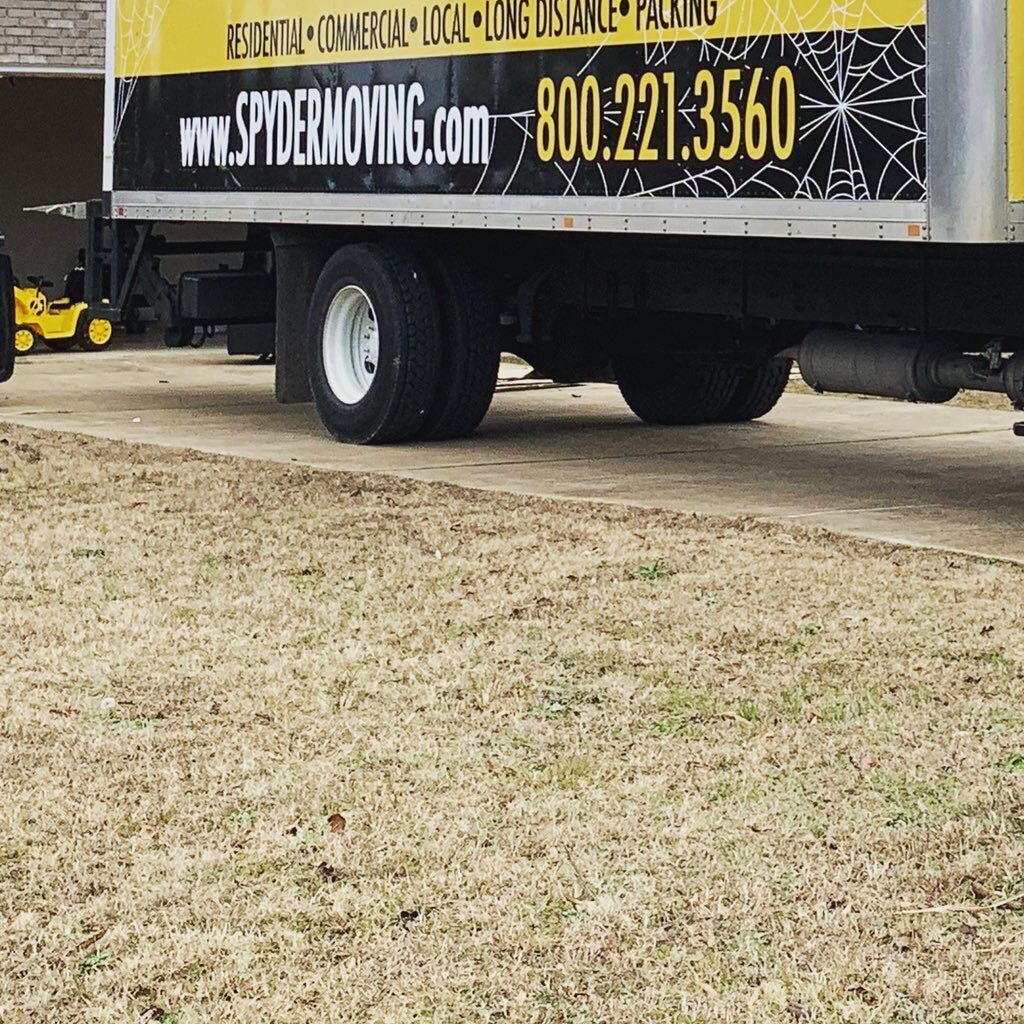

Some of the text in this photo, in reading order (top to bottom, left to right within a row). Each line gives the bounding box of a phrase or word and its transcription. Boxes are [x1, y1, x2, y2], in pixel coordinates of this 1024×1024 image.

[226, 17, 305, 60] RESIDENTIAL
[317, 7, 409, 53] COMMERCIAL
[422, 2, 470, 46] LOCAL
[179, 82, 490, 167] www.SPYDERMOVING.com
[535, 64, 796, 163] 800.221.3560
